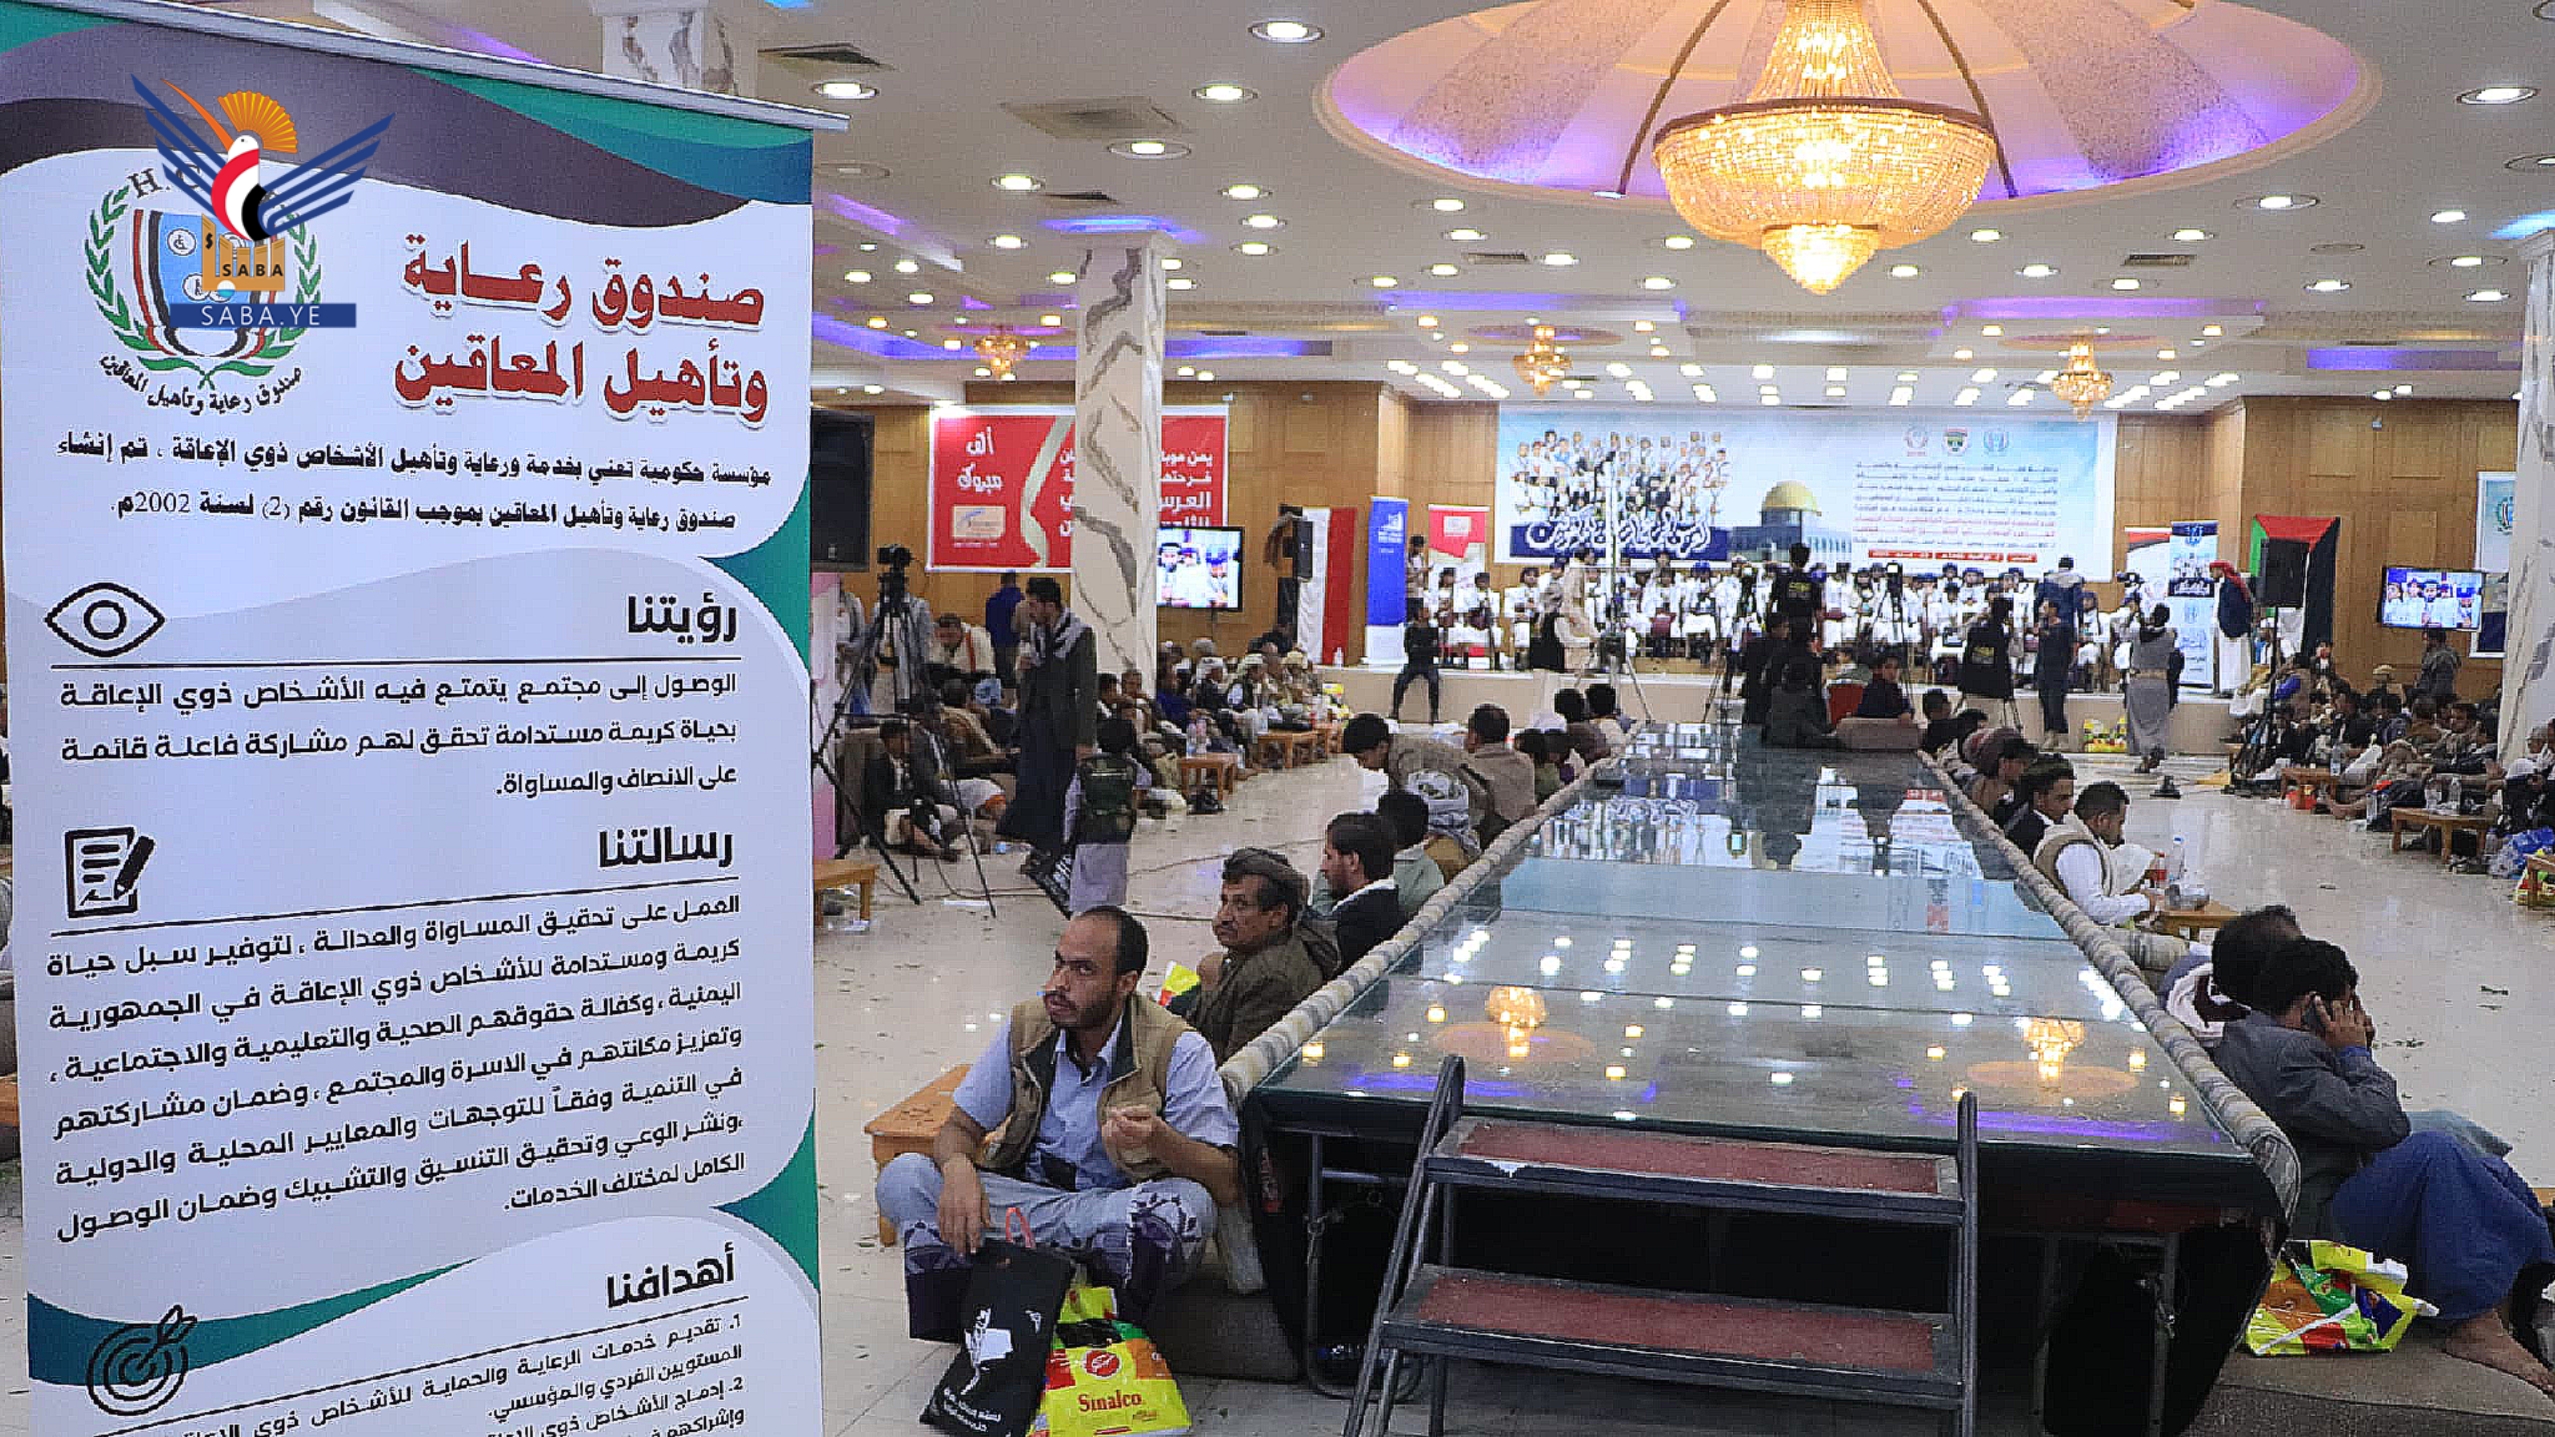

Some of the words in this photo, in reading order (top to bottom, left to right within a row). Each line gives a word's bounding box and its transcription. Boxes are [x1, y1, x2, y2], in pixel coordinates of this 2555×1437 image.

[403, 233, 572, 321] رعاية
[592, 257, 765, 328] صندوق
[395, 333, 584, 407] المعاقين
[605, 338, 768, 422] وتأهيل
[56, 431, 113, 463] إنشاء
[119, 437, 149, 465] تم
[172, 436, 236, 468] الإعاقة
[243, 441, 289, 473] ذوي
[296, 441, 384, 470] الأشخاص
[390, 442, 458, 476] وتأهيل
[463, 450, 521, 478] ورعاية
[525, 453, 583, 481] بخدمة
[587, 459, 634, 487] تعني
[639, 459, 705, 486] حكومية
[711, 462, 772, 489] مؤسسة
[199, 490, 254, 515] لسنة
[298, 495, 334, 524] رقم
[340, 496, 409, 524] القانون
[414, 504, 484, 527] بموجب
[488, 501, 557, 529] المعاقين
[563, 498, 624, 530] وتأهيل
[628, 505, 670, 533] رعاية
[675, 507, 736, 533] صندوق
[627, 592, 737, 645] رؤيتنا
[60, 683, 162, 713] الإعاقة
[172, 681, 233, 716] ذوي
[243, 675, 365, 710] الأشخاص
[374, 678, 426, 705] فيه
[434, 678, 508, 707] يتمتع
[517, 675, 601, 705] مجتمع
[609, 674, 648, 701] إلى
[654, 673, 736, 699] الوصول
[154, 733, 239, 758] فاعلة
[245, 727, 348, 759] مشاركة
[355, 728, 414, 758] لهم
[419, 725, 491, 755] تحقق
[495, 723, 604, 745] مستدامة
[608, 720, 676, 746] كريمة
[680, 719, 737, 743] بحياة
[61, 736, 148, 761] قائمة
[617, 765, 693, 788] الانصاف
[698, 764, 737, 791] على
[599, 825, 733, 868] رسالتنا
[536, 906, 615, 937] تحقيق
[621, 903, 668, 930] على
[673, 894, 740, 923] العمل
[313, 925, 417, 952] والعدالة
[424, 913, 531, 945] المساواة
[46, 953, 116, 980] حياة
[125, 946, 197, 974] سبل
[204, 935, 292, 967] لتوفير
[550, 950, 668, 976] ومستدامة
[673, 938, 740, 964] كريمة
[371, 970, 422, 1006] ذوي
[429, 955, 543, 994] للأشخاص
[211, 986, 261, 1018] في
[270, 976, 363, 1006] الإعاقة
[580, 993, 654, 1018] وكفالة
[668, 981, 741, 1011] اليمنية
[49, 992, 201, 1033] الجمهورية
[466, 1002, 575, 1038] حقوقهم
[234, 1026, 371, 1063] والتعليمية
[376, 1013, 462, 1047] الصحية
[675, 1026, 742, 1056] وتعزيز
[64, 1042, 227, 1082] والاجتماعية
[451, 1051, 526, 1083] الاسرة
[530, 1046, 572, 1081] في
[577, 1036, 672, 1071] مكانتهم
[326, 1065, 445, 1105] والمجتمع
[622, 1073, 697, 1105] التنمية
[704, 1066, 742, 1100] في
[212, 1082, 309, 1117] وضمان
[428, 1096, 545, 1130] للتوجهات
[52, 1091, 206, 1141] مشاركتهم
[187, 1131, 294, 1168] المحلية
[303, 1115, 417, 1155] والمعايير
[614, 1120, 678, 1159] الوعي
[414, 1146, 509, 1186] التنسيق
[515, 1134, 609, 1169] وتحقيق
[56, 1149, 176, 1187] والدولية
[284, 1164, 407, 1203] والتشبيك
[602, 1163, 679, 1194] لمختلف
[684, 1152, 745, 1184] الكامل
[177, 1185, 277, 1222] وضمان
[57, 1198, 169, 1243] الوصول
[607, 1241, 735, 1309] أهدافنا
[592, 1332, 657, 1360] خدمات
[666, 1317, 722, 1349] تقديم
[517, 1348, 581, 1377] الرعاية
[658, 1343, 742, 1382] المستويين
[422, 1367, 508, 1398] والحماية
[599, 1366, 655, 1401] الفردي
[674, 1379, 725, 1411] إدماج
[311, 1385, 412, 1427] للأشخاص
[585, 1394, 669, 1431] الأشخاص
[1078, 1389, 1143, 1412] Sinalco
